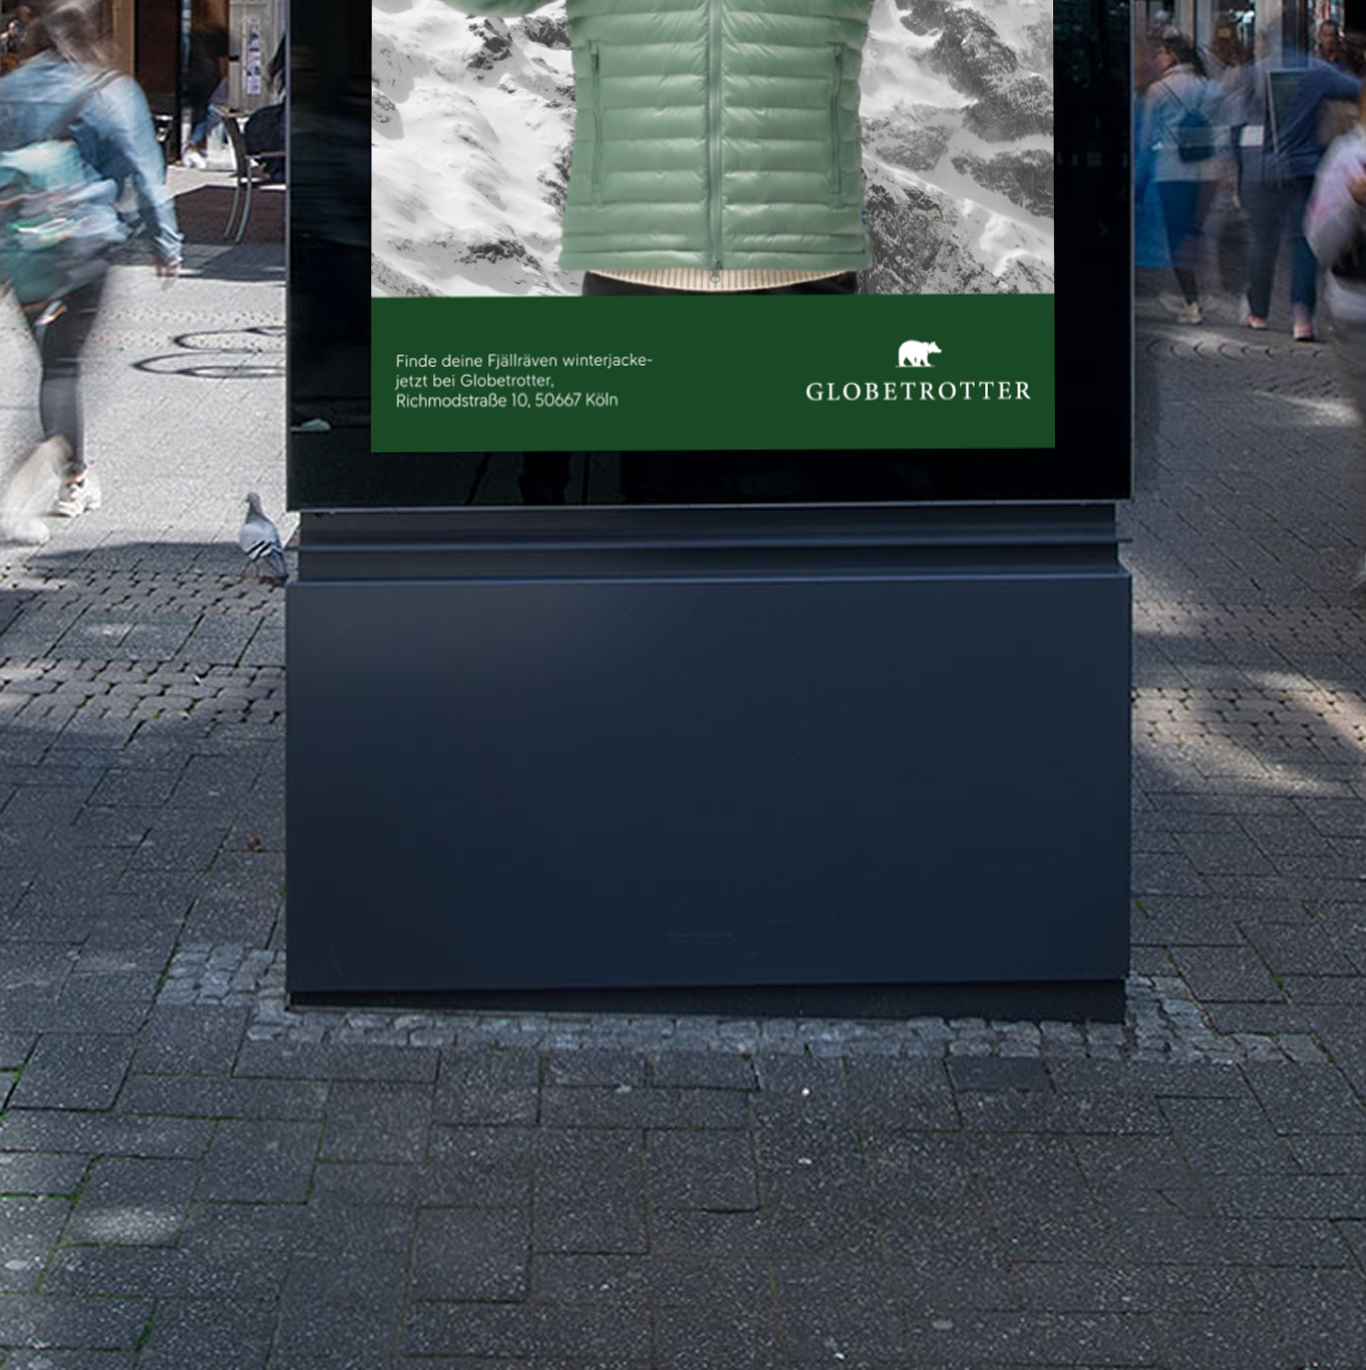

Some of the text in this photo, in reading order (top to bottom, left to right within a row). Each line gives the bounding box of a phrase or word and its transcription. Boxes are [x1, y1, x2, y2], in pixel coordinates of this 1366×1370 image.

[396, 352, 654, 370] Finde deine Fjällräven winterjacke-
[394, 373, 555, 390] jetzt bei Globetrotter,
[805, 381, 1032, 401] GLOBETROTTER
[396, 392, 619, 409] Richmodstraße 10, 50667 Köln
